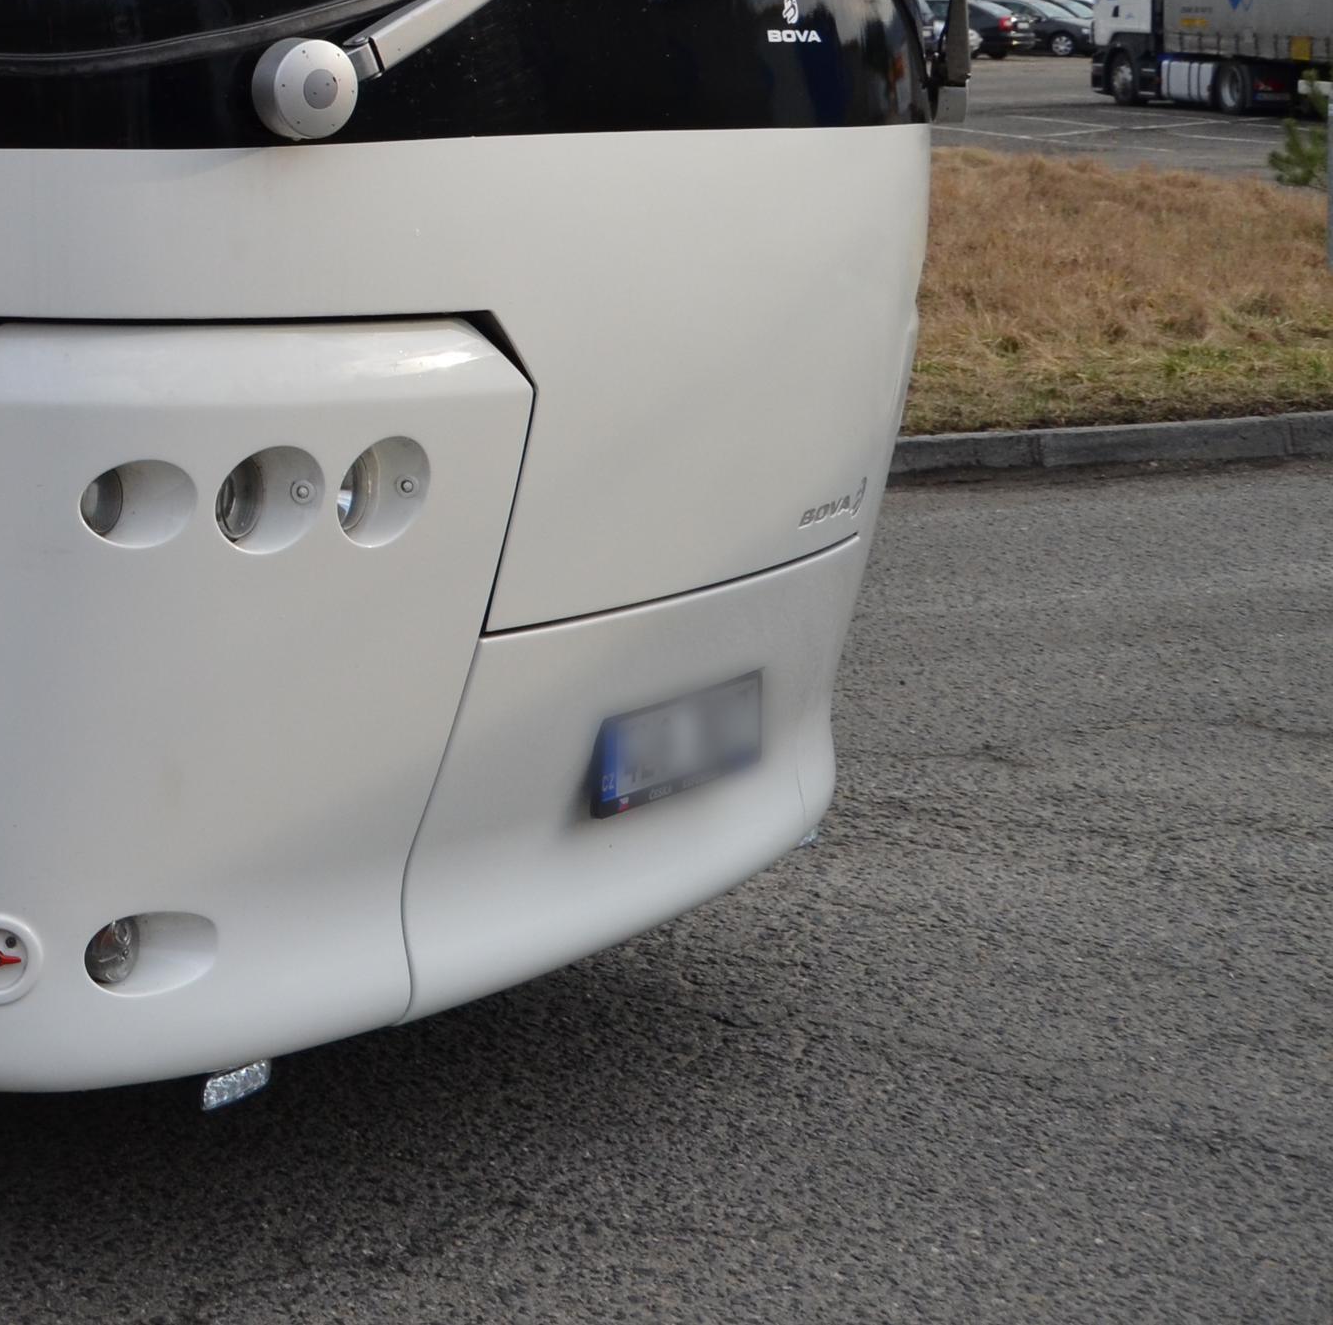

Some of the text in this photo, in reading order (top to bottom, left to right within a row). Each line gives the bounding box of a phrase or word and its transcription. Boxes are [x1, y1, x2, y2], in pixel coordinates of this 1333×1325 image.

[766, 29, 822, 43] BOVA
[797, 495, 851, 530] BOVA
[601, 772, 615, 791] CZ
